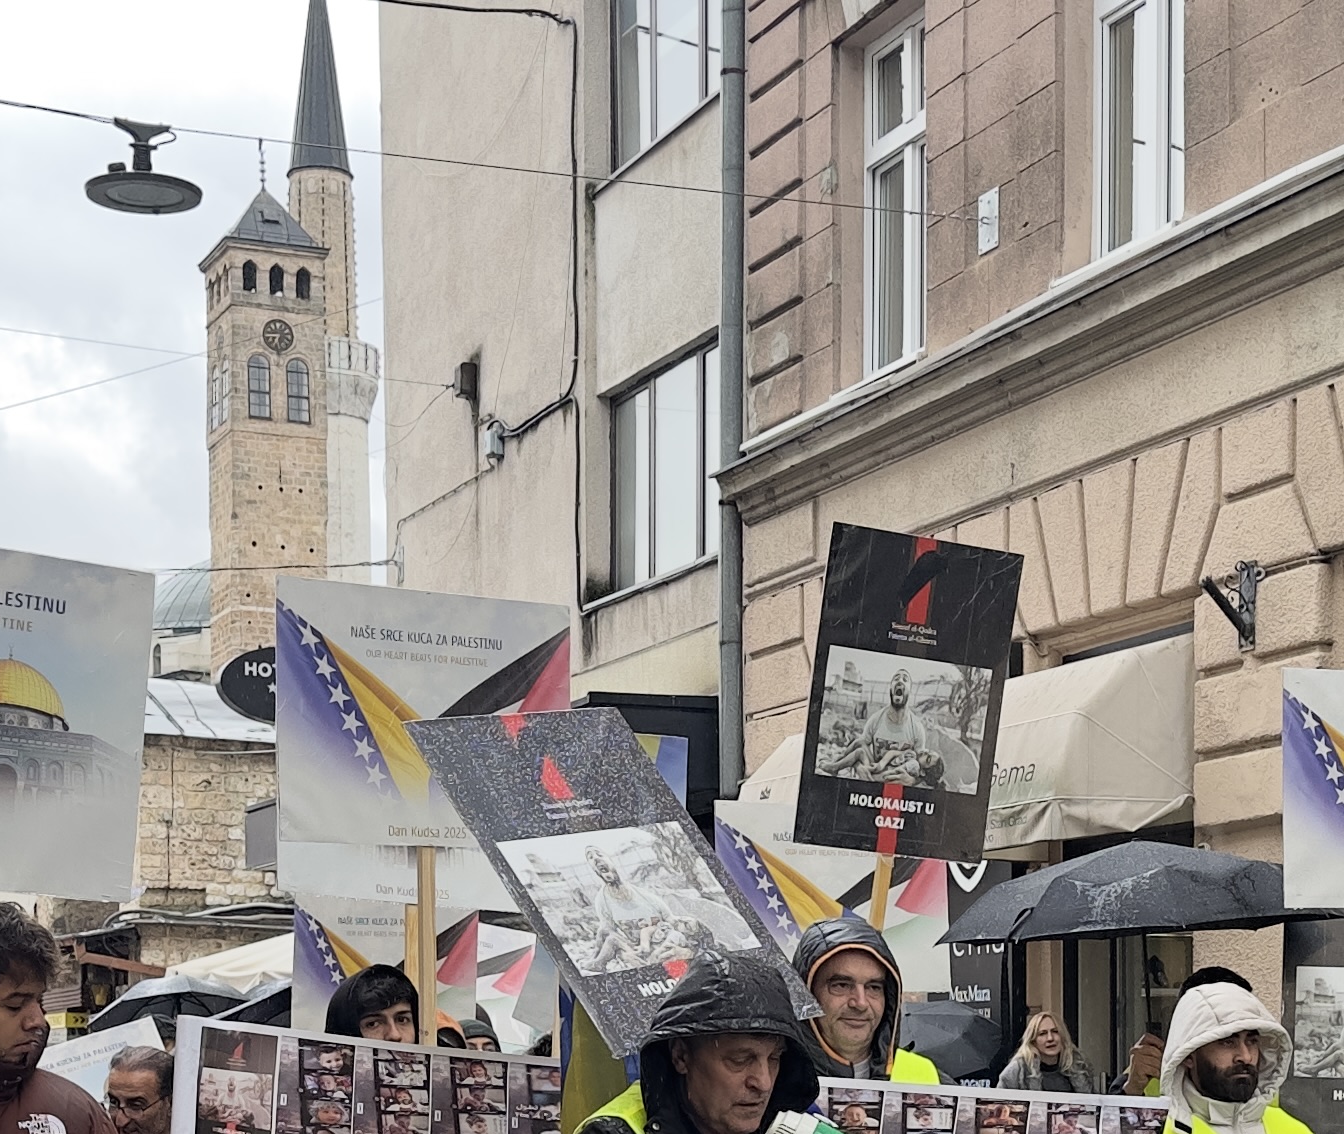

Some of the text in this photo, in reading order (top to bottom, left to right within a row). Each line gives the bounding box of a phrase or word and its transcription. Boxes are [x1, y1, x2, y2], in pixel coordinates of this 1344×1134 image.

[350, 624, 503, 651] NAŠE SRCE KUCA ZA PALESTINU
[244, 661, 276, 678] HO
[849, 792, 935, 815] HOLOKAUST U
[874, 815, 905, 830] GAZI
[388, 825, 407, 837] Dan
[411, 826, 440, 838] Kudsa
[376, 883, 394, 895] Dan
[949, 984, 991, 1002] MaxMara
